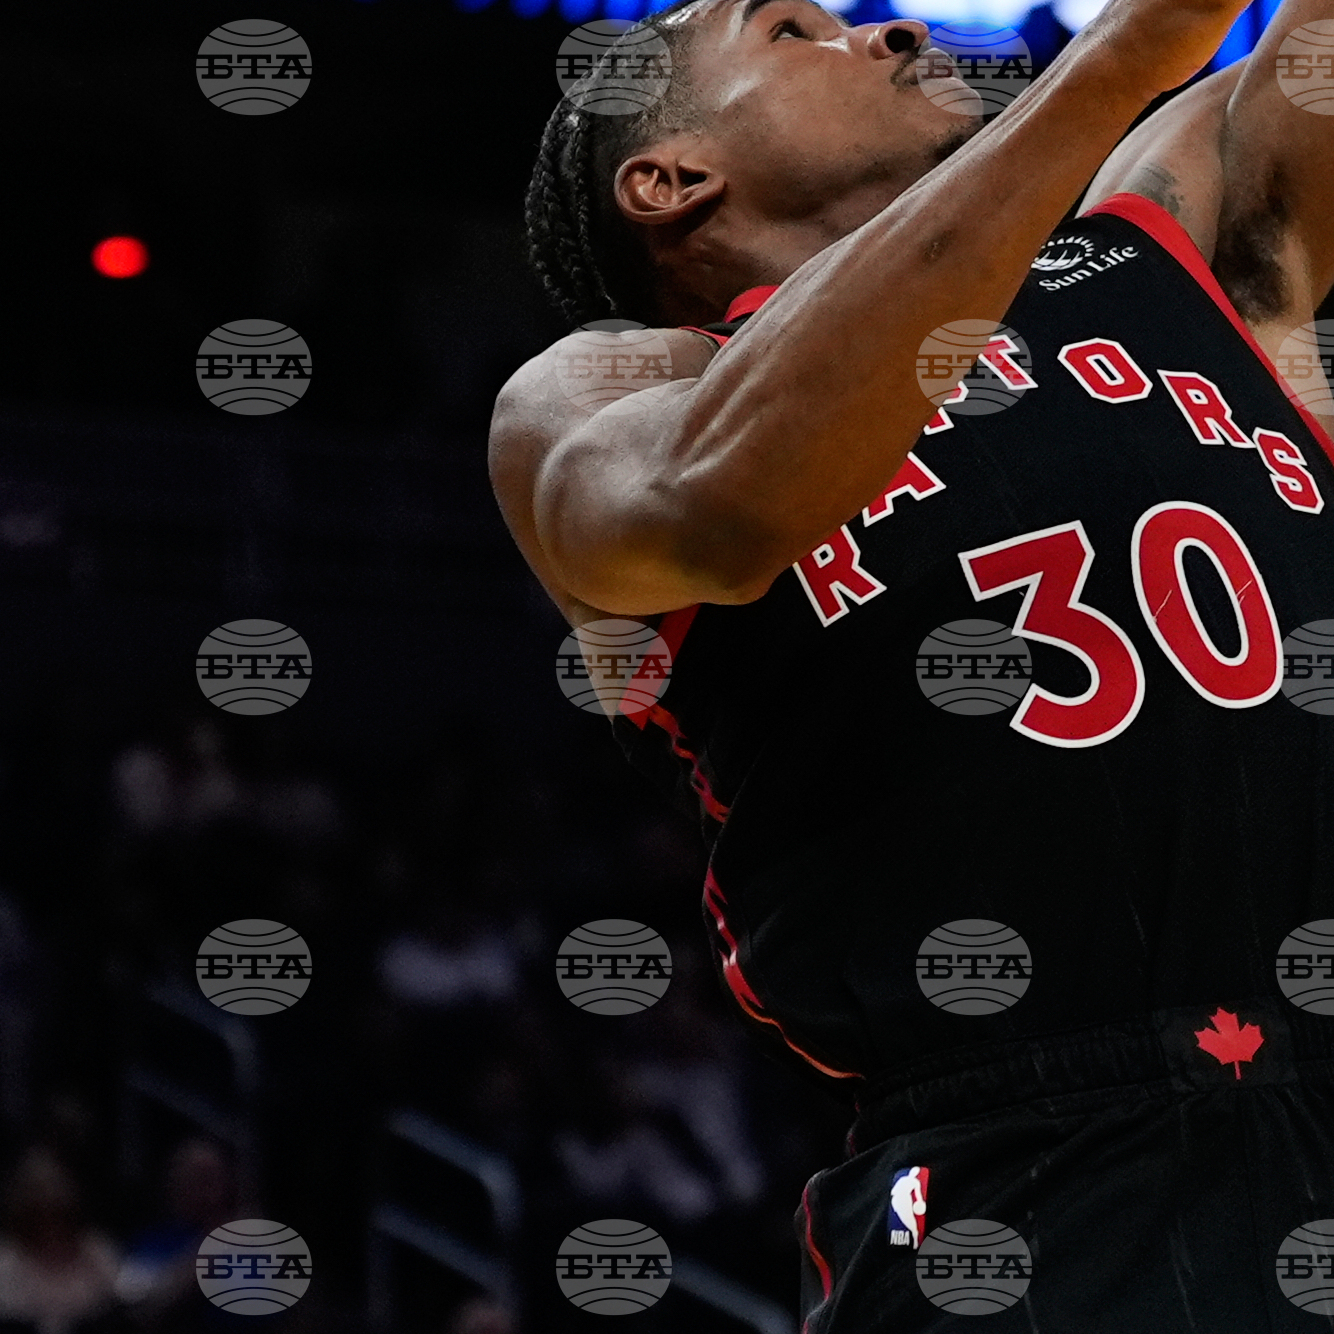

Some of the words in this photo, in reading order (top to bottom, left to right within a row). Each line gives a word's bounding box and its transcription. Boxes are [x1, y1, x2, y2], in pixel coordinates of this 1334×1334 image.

[1038, 269, 1093, 292] Sun
[1086, 246, 1139, 272] Life
[792, 334, 1324, 627] RATORS
[958, 501, 1285, 748] 30
[889, 1229, 910, 1245] NBA
